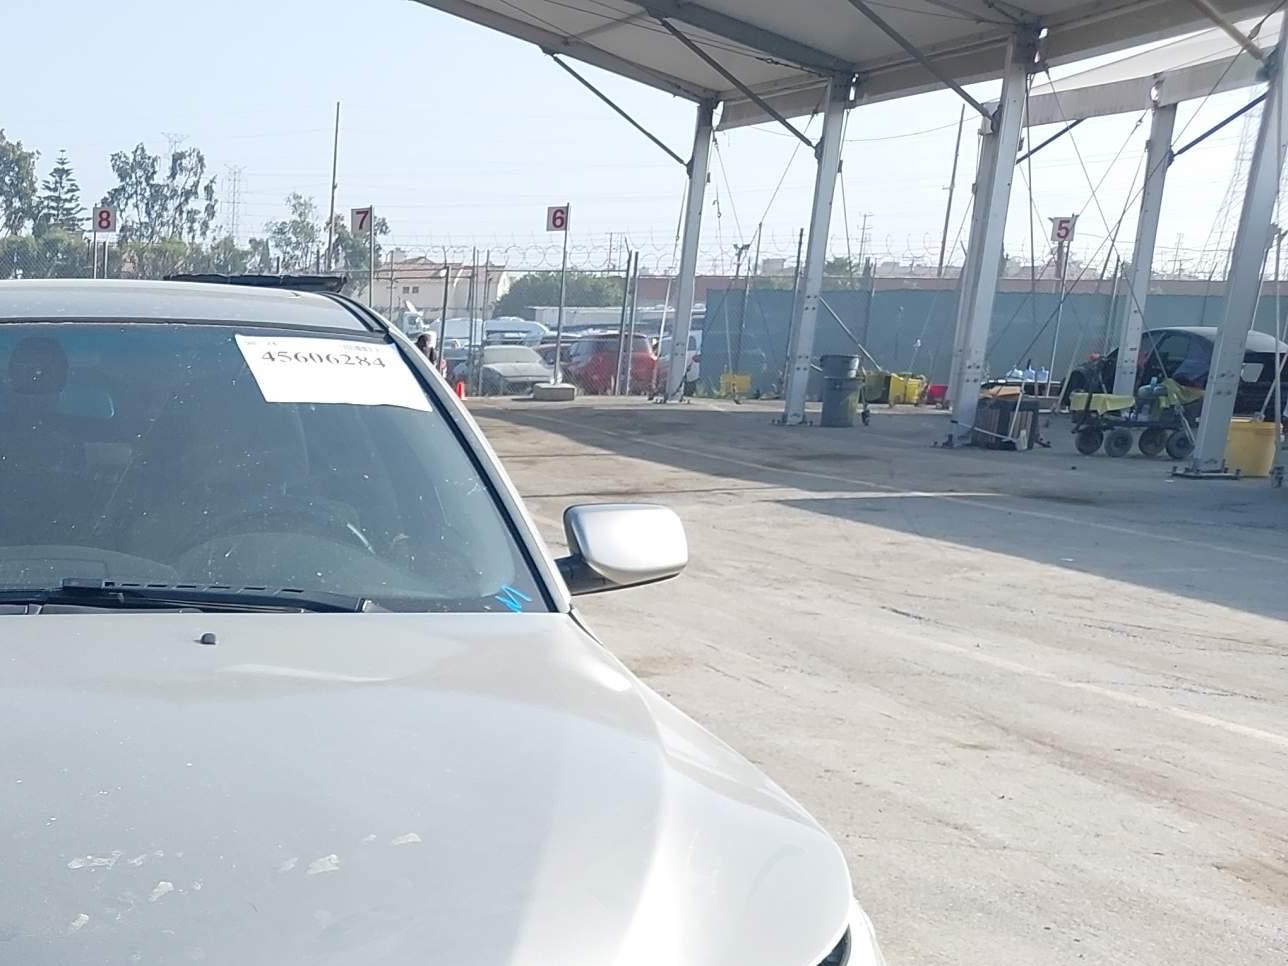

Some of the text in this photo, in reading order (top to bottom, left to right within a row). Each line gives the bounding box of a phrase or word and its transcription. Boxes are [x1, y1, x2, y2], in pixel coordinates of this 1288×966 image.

[98, 210, 111, 229] 8
[355, 210, 369, 231] 7
[552, 208, 565, 228] 6
[1056, 219, 1071, 239] 5
[261, 351, 386, 368] 45606284
